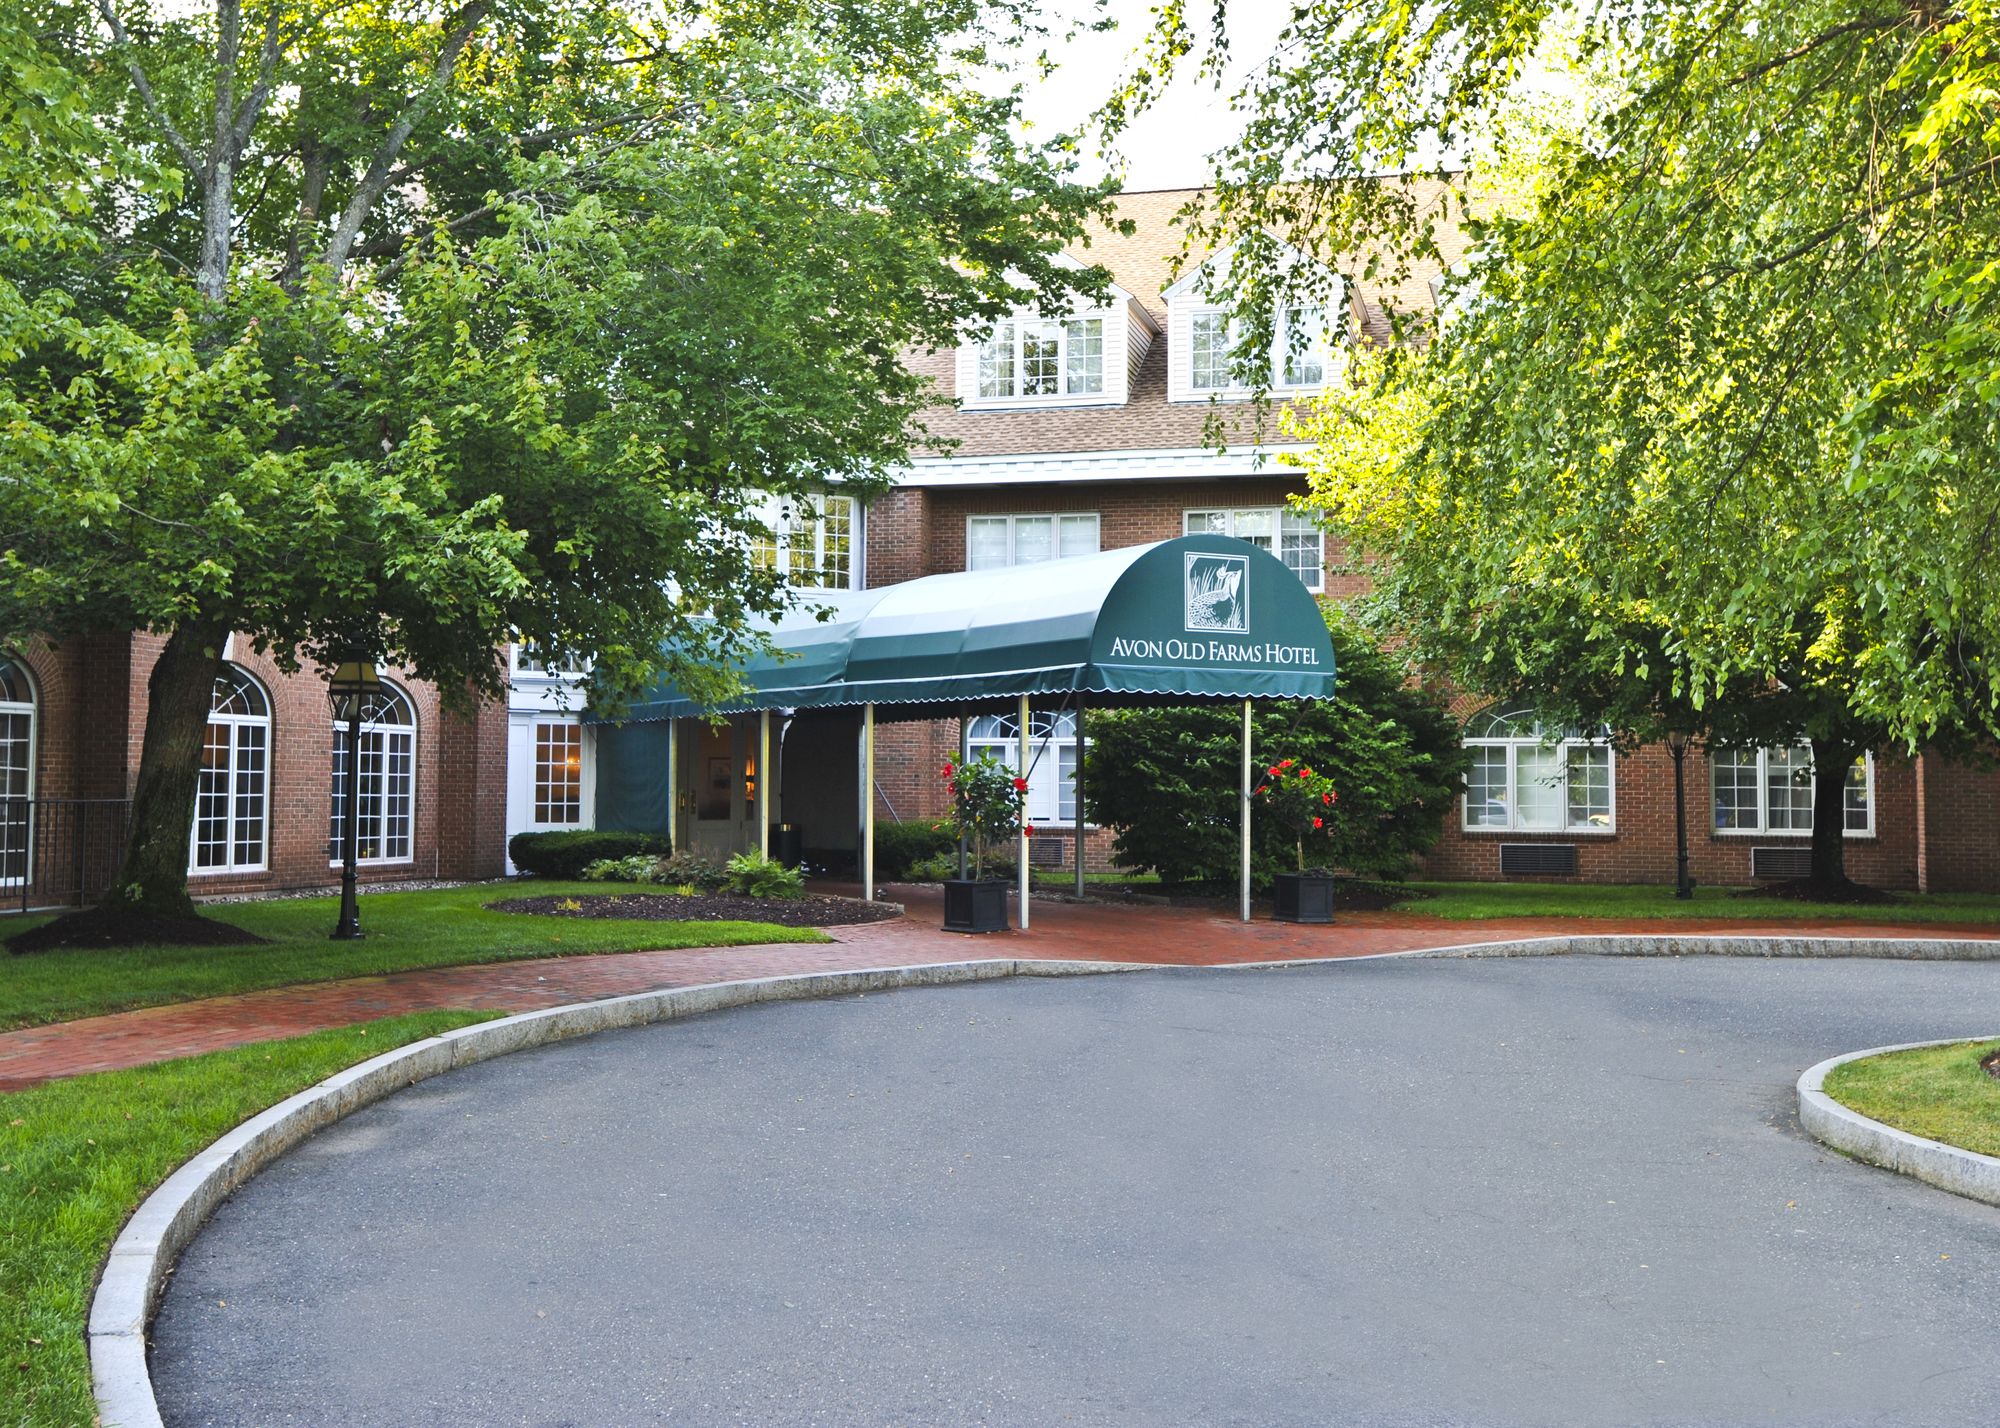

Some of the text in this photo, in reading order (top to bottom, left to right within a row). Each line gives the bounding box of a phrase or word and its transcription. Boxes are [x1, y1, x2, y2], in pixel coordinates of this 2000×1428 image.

[1110, 636, 1319, 665] AVON OLD FARMS HOTEL
